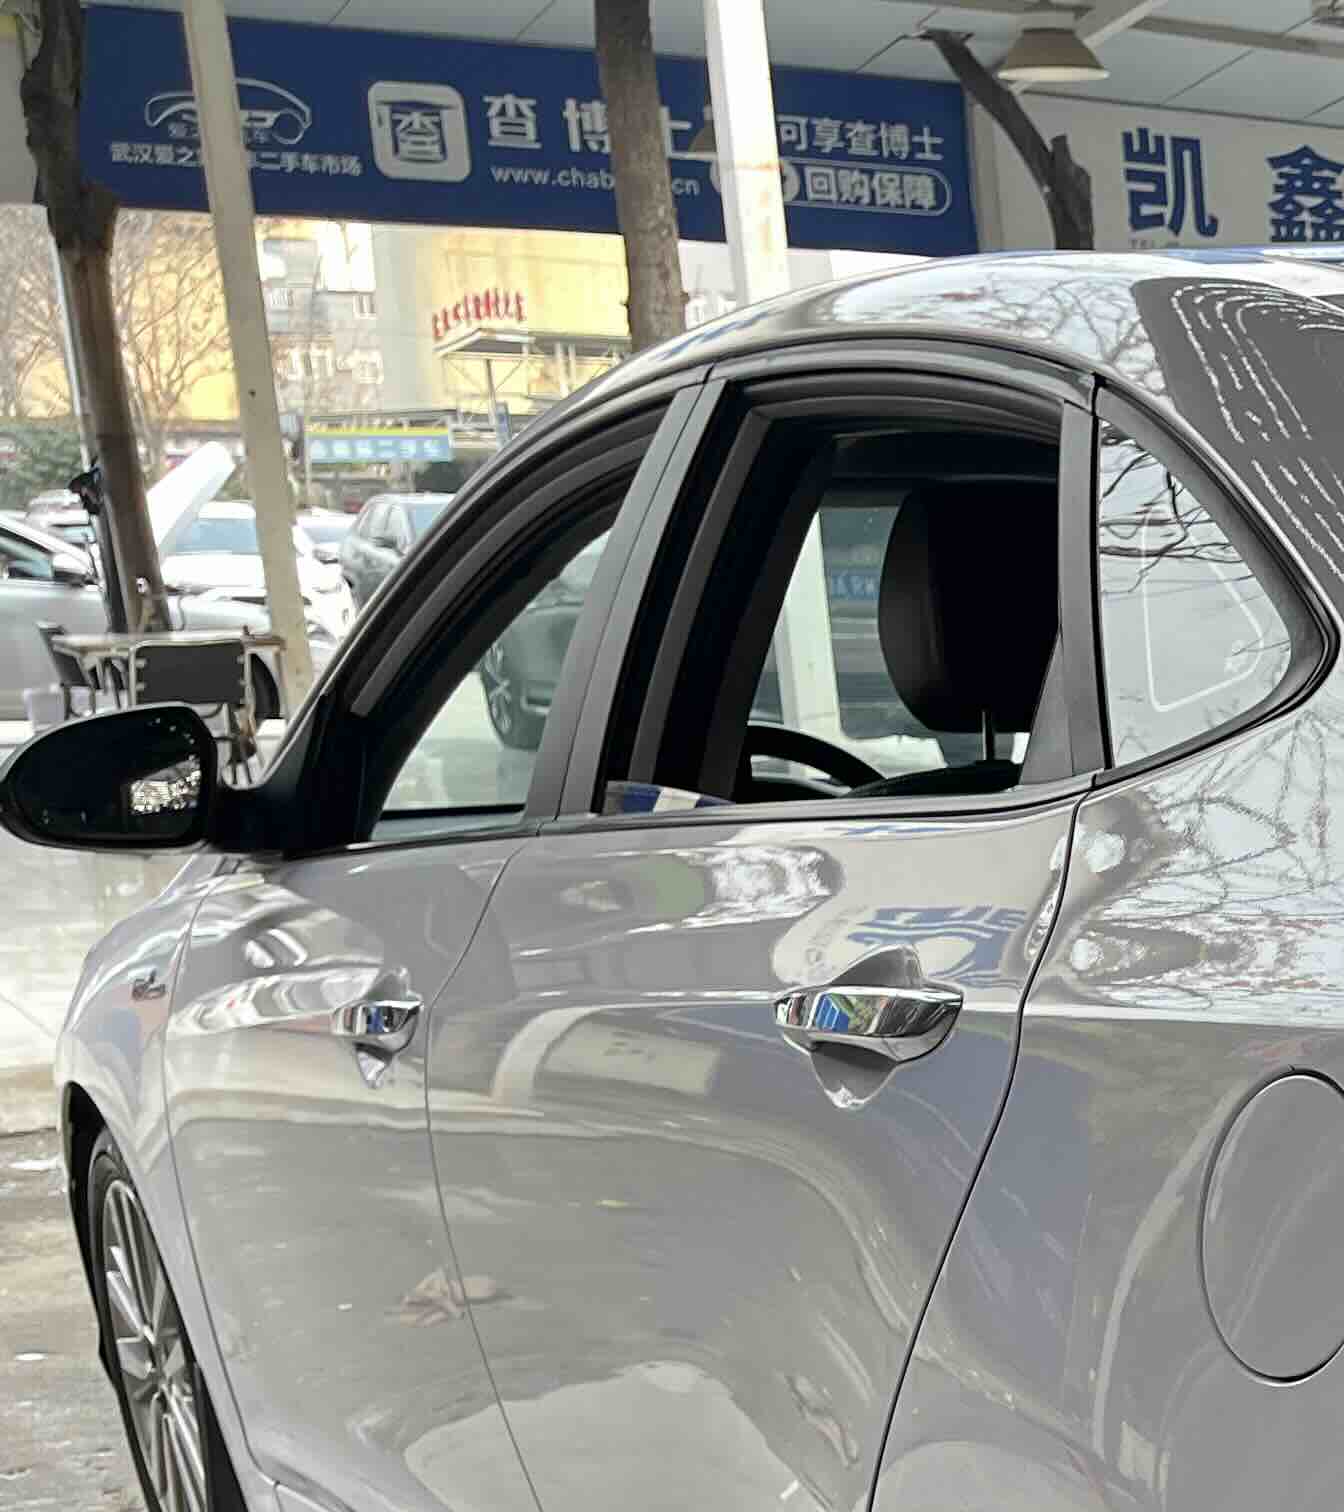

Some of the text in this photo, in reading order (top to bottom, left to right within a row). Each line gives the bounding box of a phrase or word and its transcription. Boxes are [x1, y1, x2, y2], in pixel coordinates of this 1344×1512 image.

[110, 142, 363, 177] 武汉爱之二手车市场
[491, 164, 701, 197] www.chabcn
